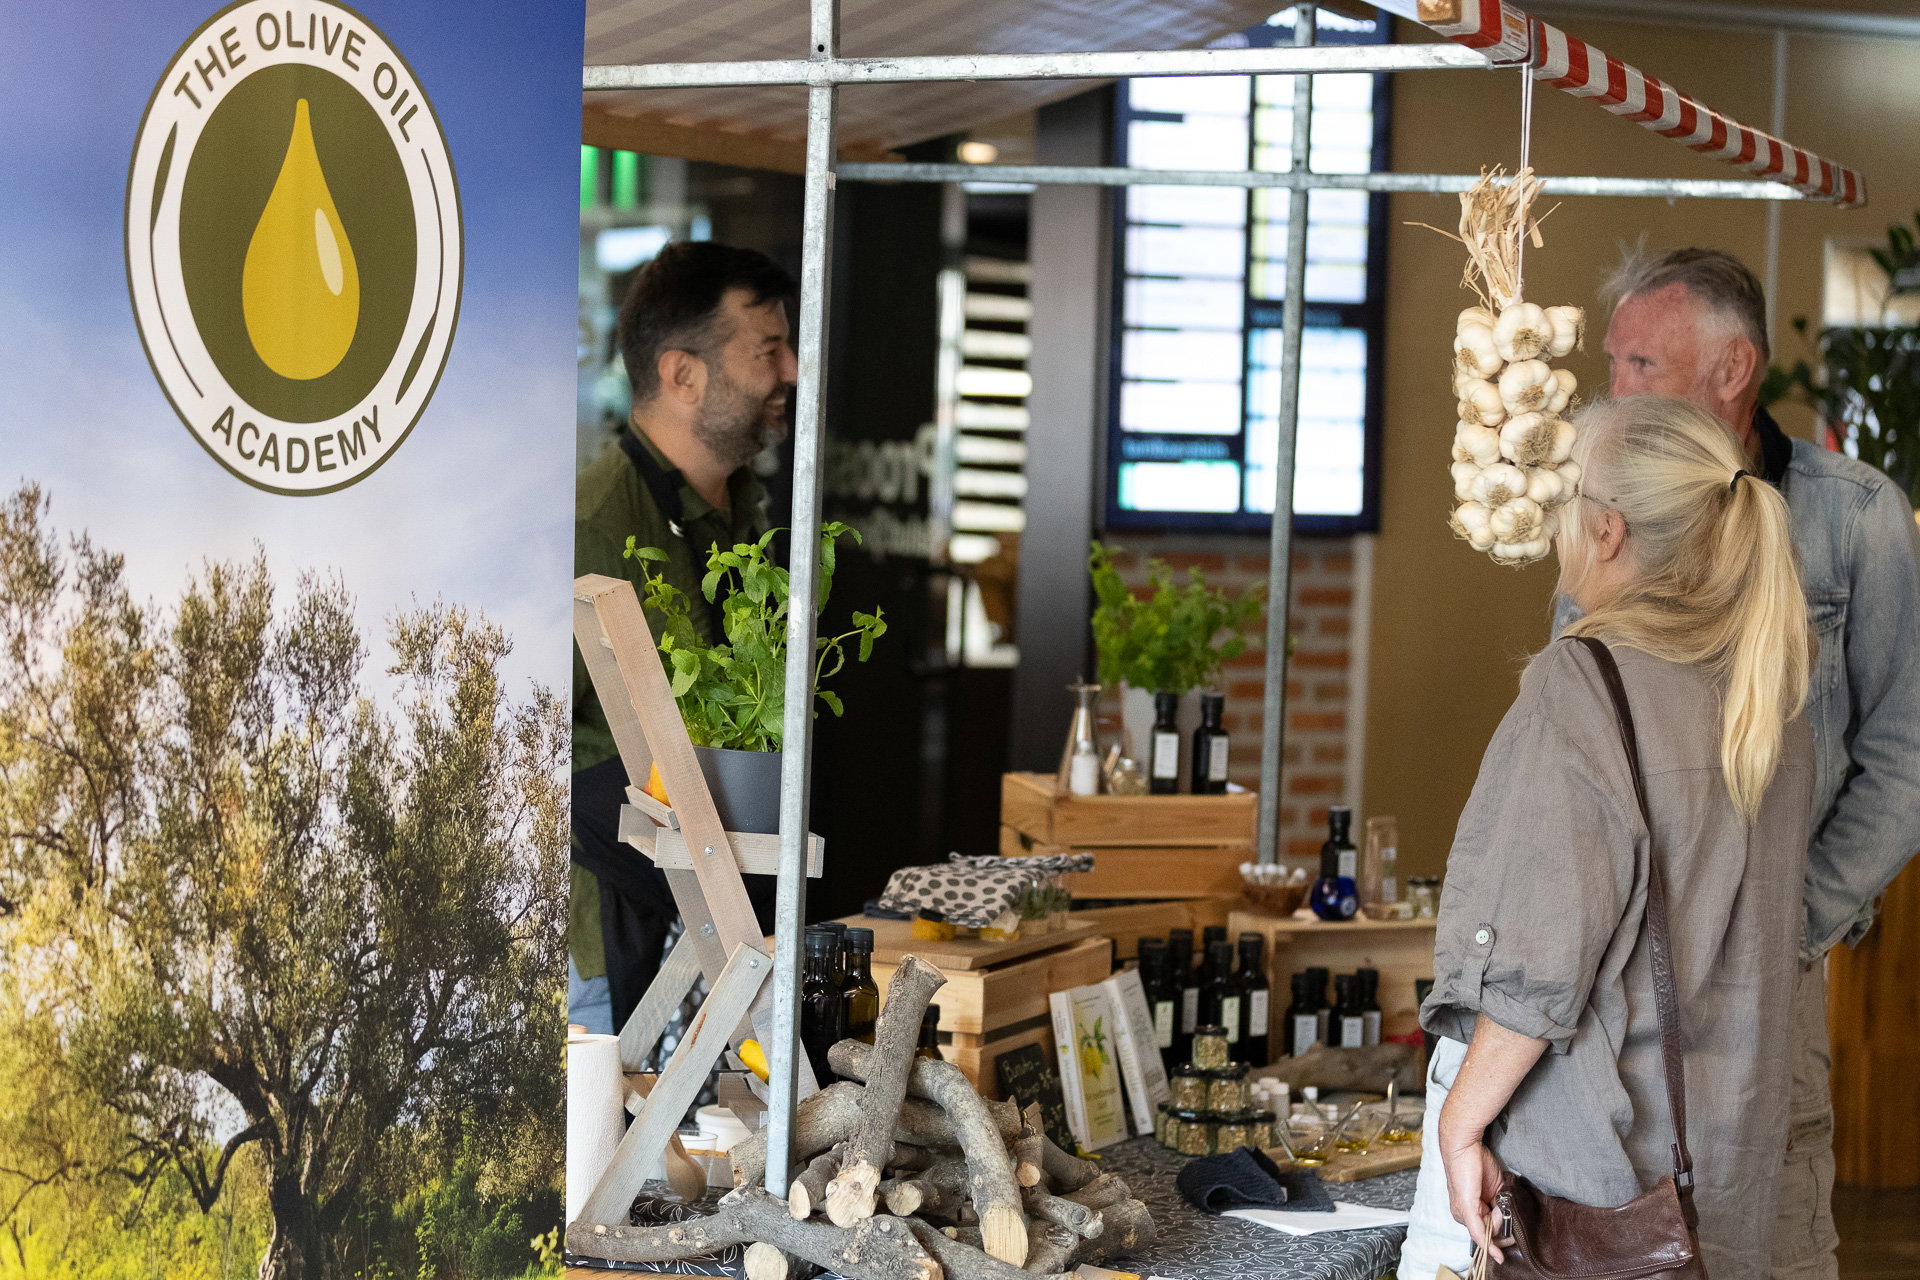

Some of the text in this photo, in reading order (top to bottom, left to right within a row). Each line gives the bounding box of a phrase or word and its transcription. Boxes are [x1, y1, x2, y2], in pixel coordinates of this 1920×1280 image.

[174, 11, 418, 143] THE OLIVE OIL
[211, 405, 382, 474] ACADEMY
